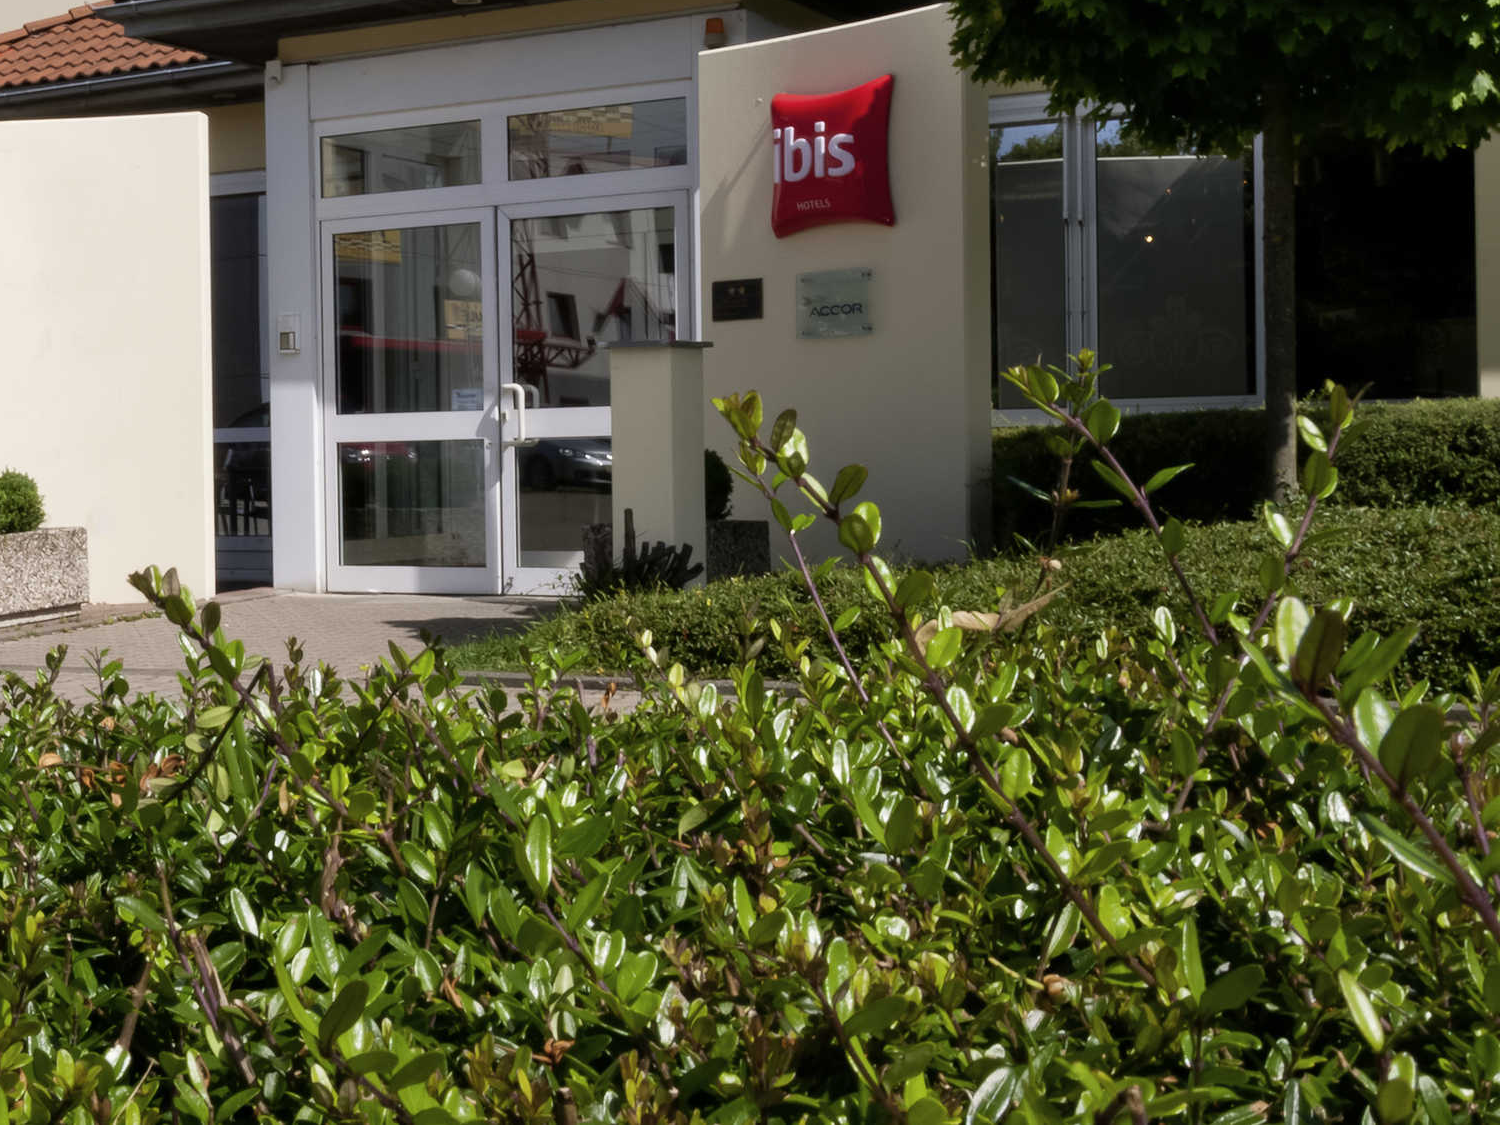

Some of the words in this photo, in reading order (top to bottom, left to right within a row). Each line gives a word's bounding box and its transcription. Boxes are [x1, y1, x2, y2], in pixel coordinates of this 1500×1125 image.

[773, 121, 855, 184] ibis
[796, 199, 831, 211] HOTELS
[810, 303, 863, 317] ACCOR
